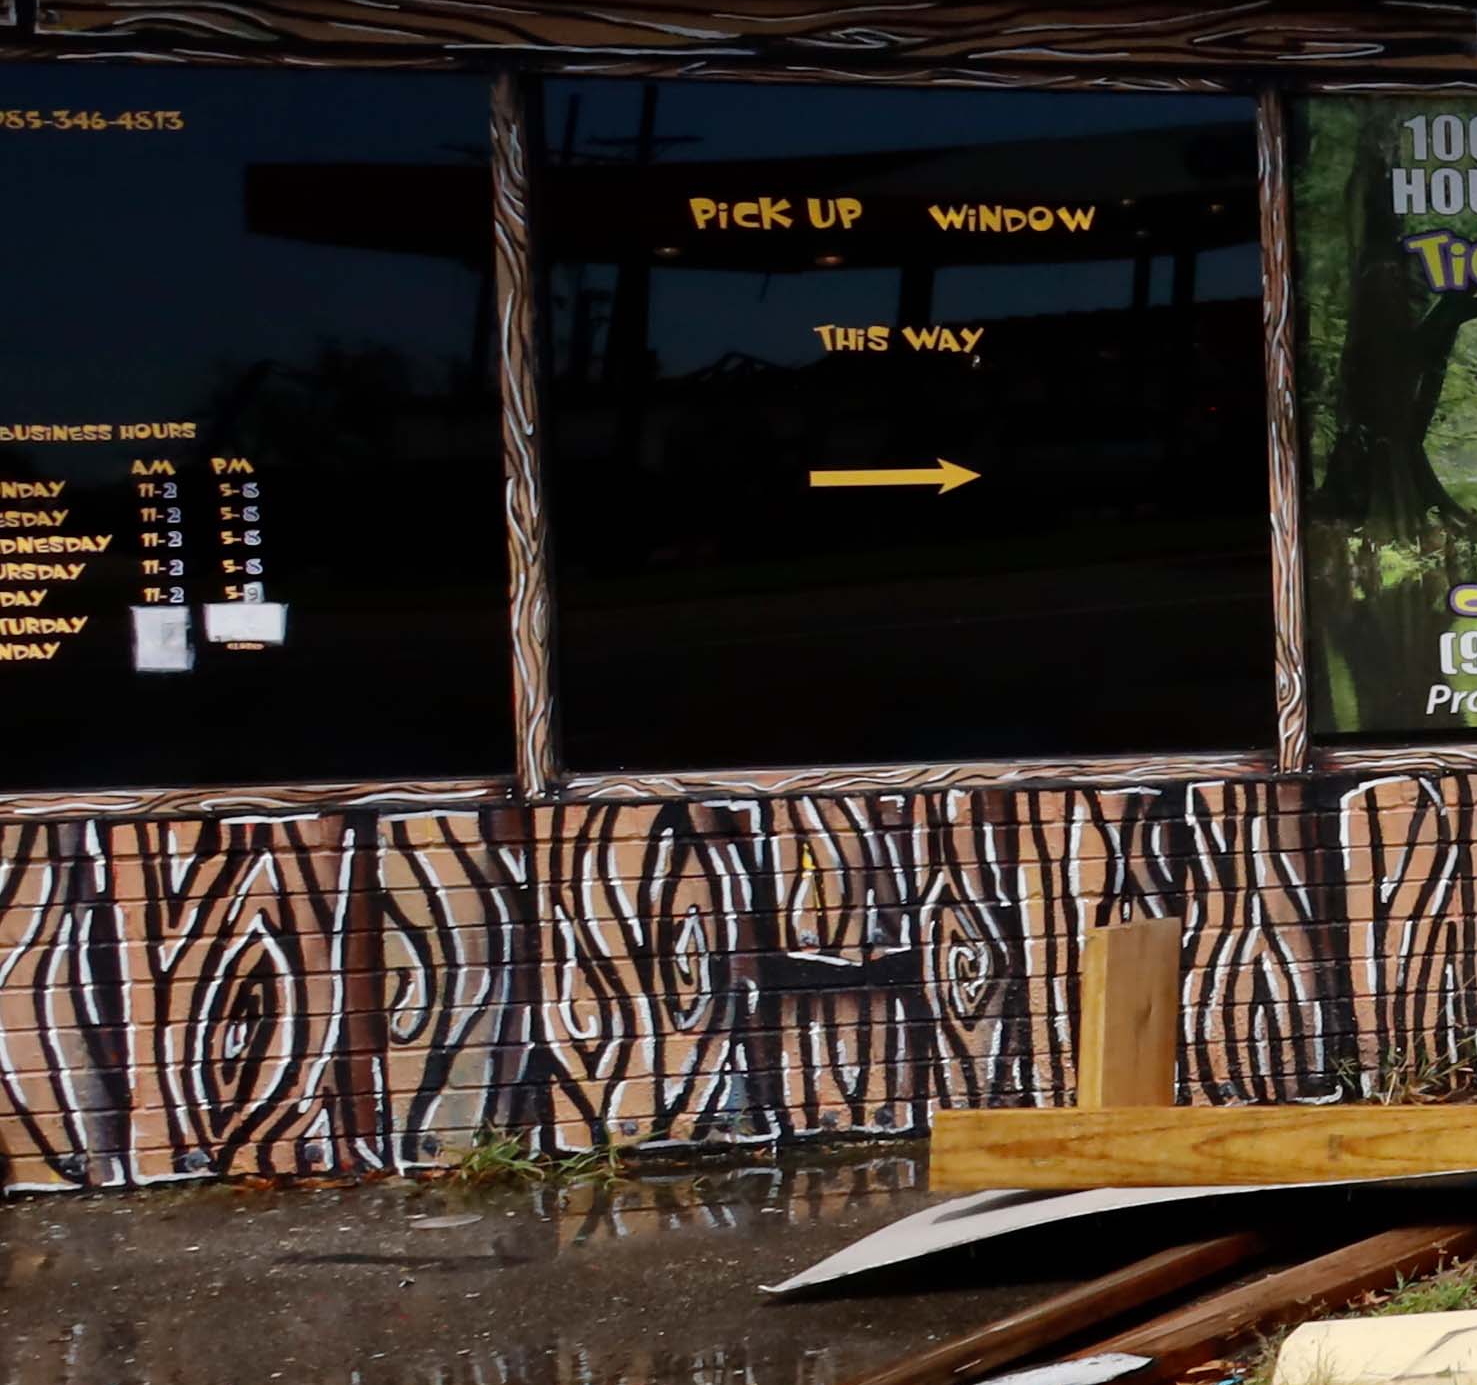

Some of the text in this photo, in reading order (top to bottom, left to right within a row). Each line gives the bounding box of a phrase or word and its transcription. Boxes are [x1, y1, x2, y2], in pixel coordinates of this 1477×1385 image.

[688, 197, 1096, 233] PiCK UP WiNDOW
[813, 324, 985, 353] THiS WAY
[0, 422, 196, 442] BUSiNESS HOURS
[131, 457, 254, 475] AM PM
[0, 480, 66, 499] NDAY
[138, 482, 178, 498] 11-2
[140, 507, 181, 523] 11-2
[142, 530, 183, 547] 11-2
[142, 559, 184, 576] 11-2
[143, 586, 185, 603] 11-2
